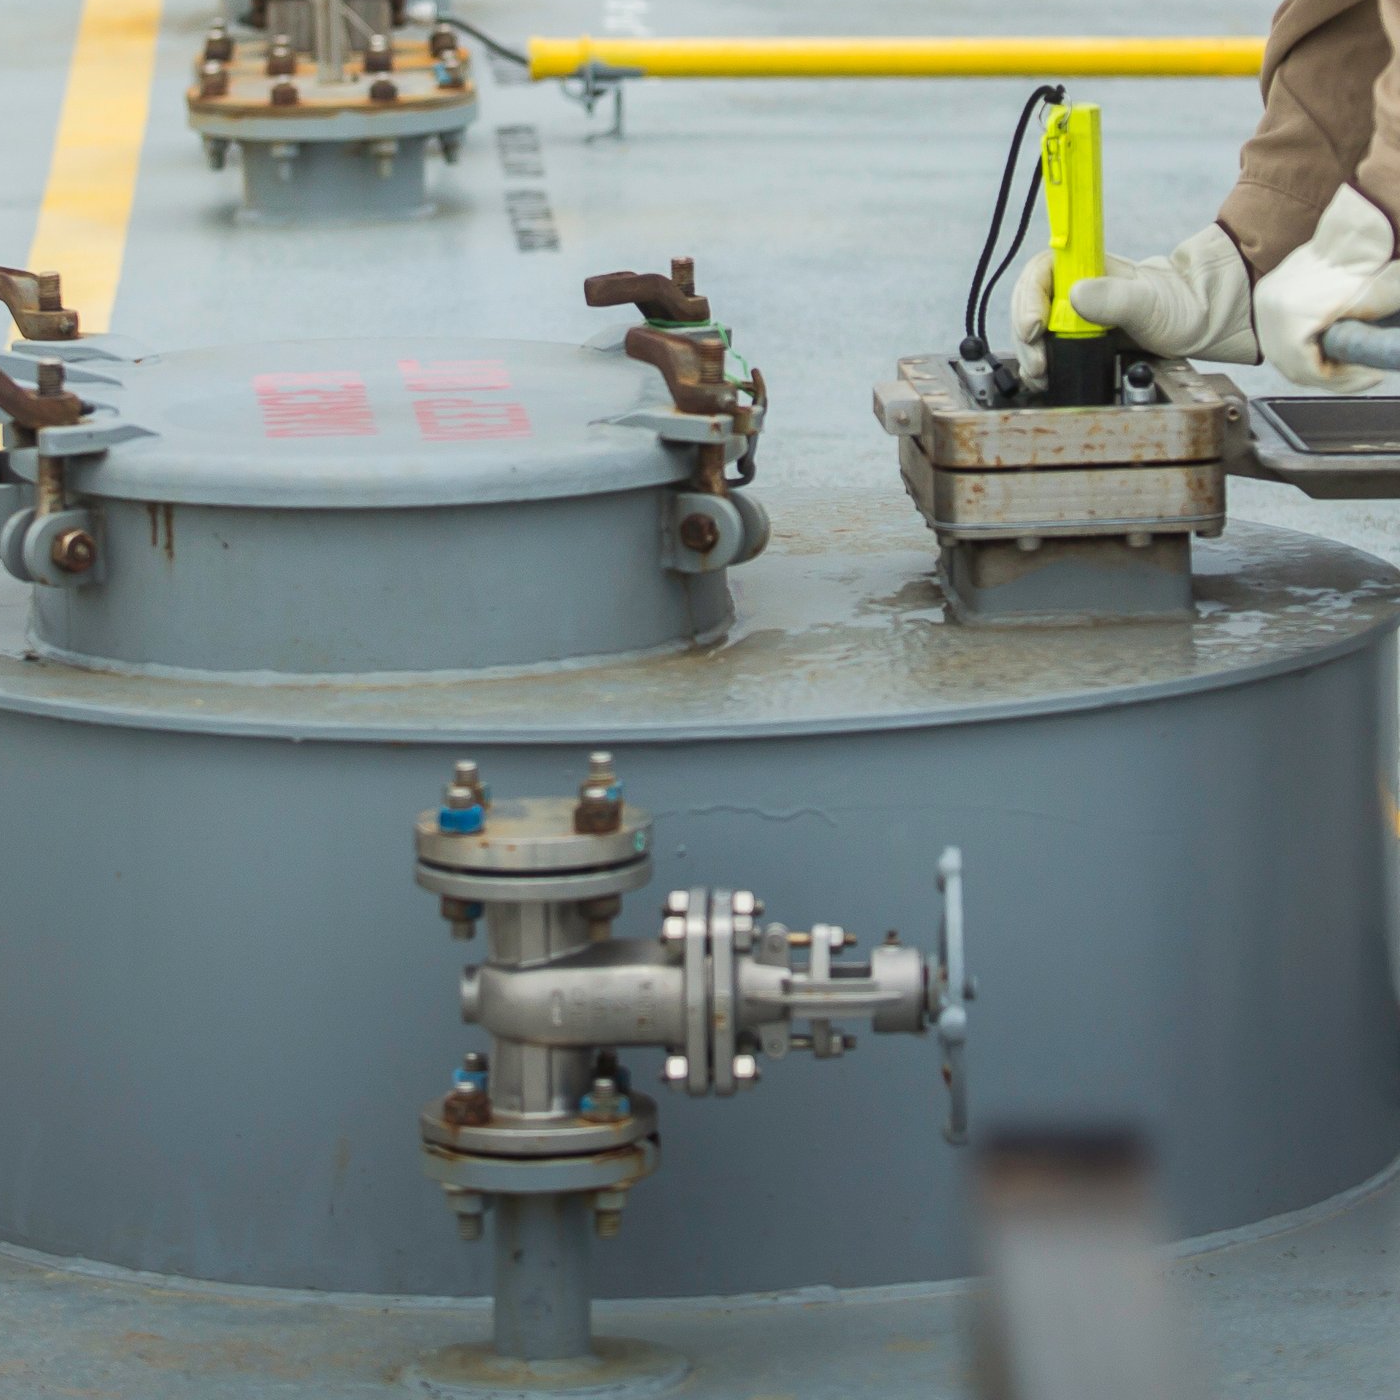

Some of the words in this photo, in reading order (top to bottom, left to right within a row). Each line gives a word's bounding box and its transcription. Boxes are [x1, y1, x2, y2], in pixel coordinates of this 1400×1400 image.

[397, 359, 512, 392] OUT
[251, 370, 378, 438] DANGER
[412, 398, 536, 441] KEEP
